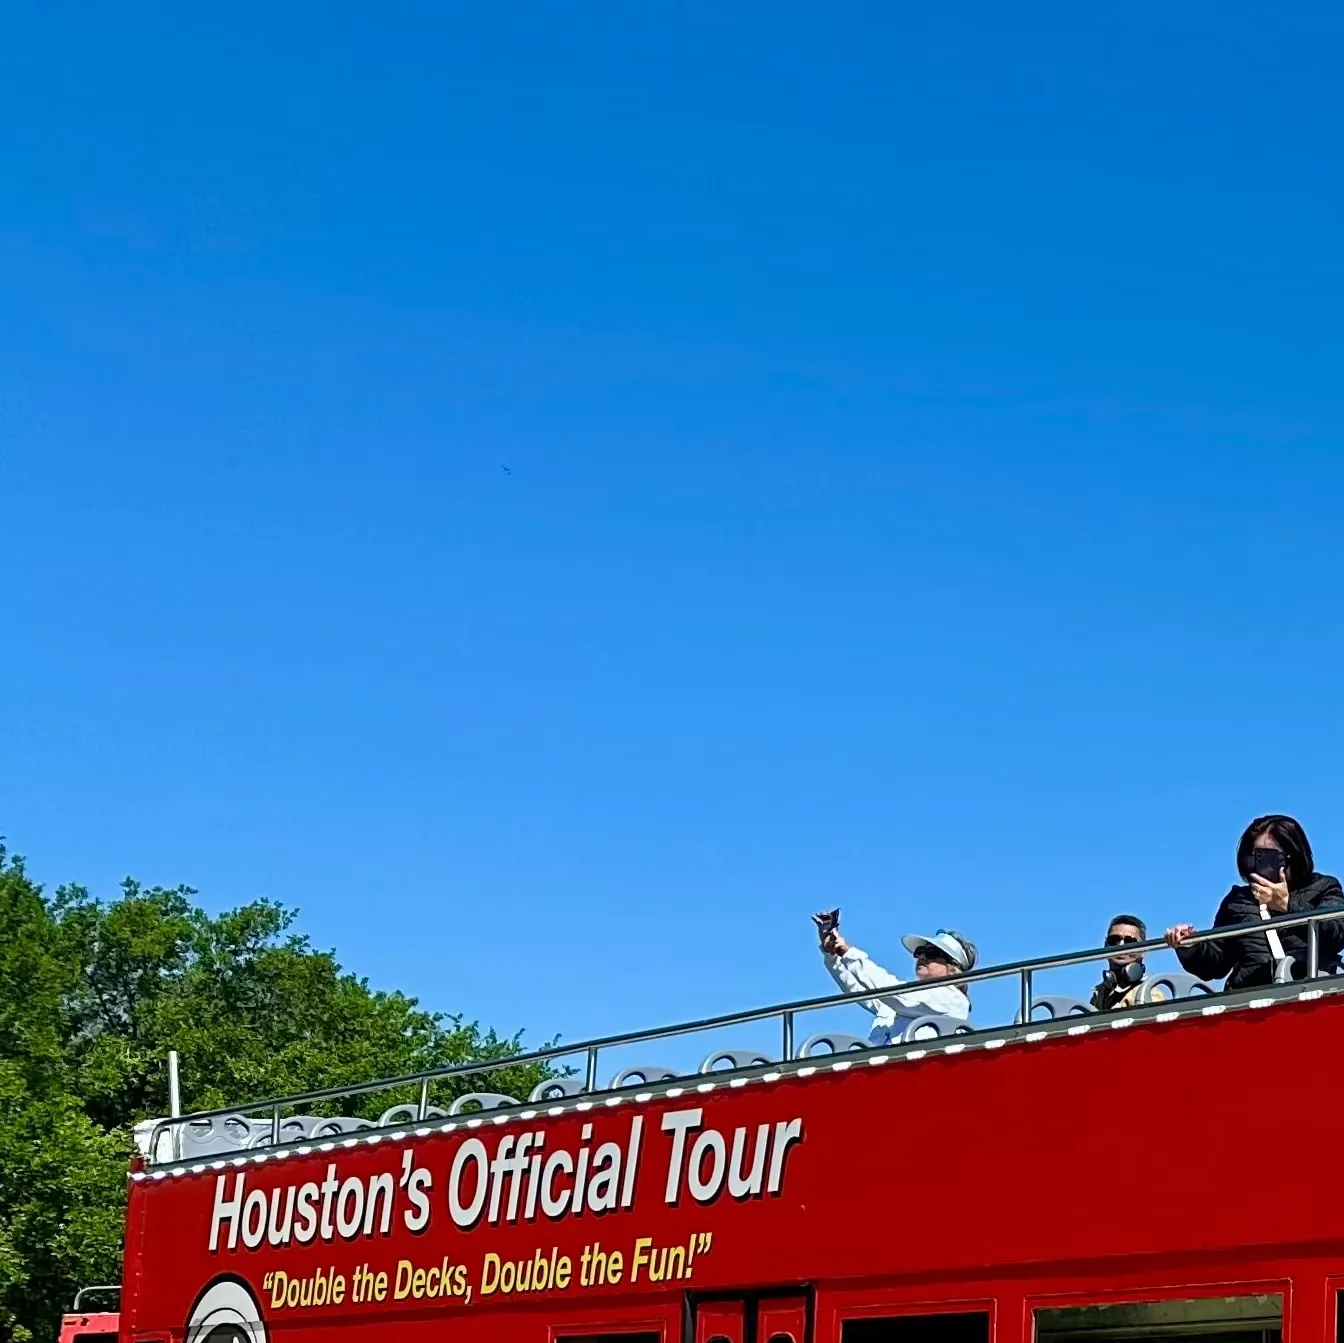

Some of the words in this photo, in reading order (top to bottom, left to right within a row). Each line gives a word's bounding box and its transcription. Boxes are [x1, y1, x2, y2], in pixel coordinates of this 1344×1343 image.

[449, 1117, 643, 1229] Official
[660, 1107, 802, 1203] Tour
[352, 1264, 388, 1300] the
[395, 1256, 473, 1304] Decks,
[480, 1246, 569, 1295] Double
[579, 1242, 624, 1284] the
